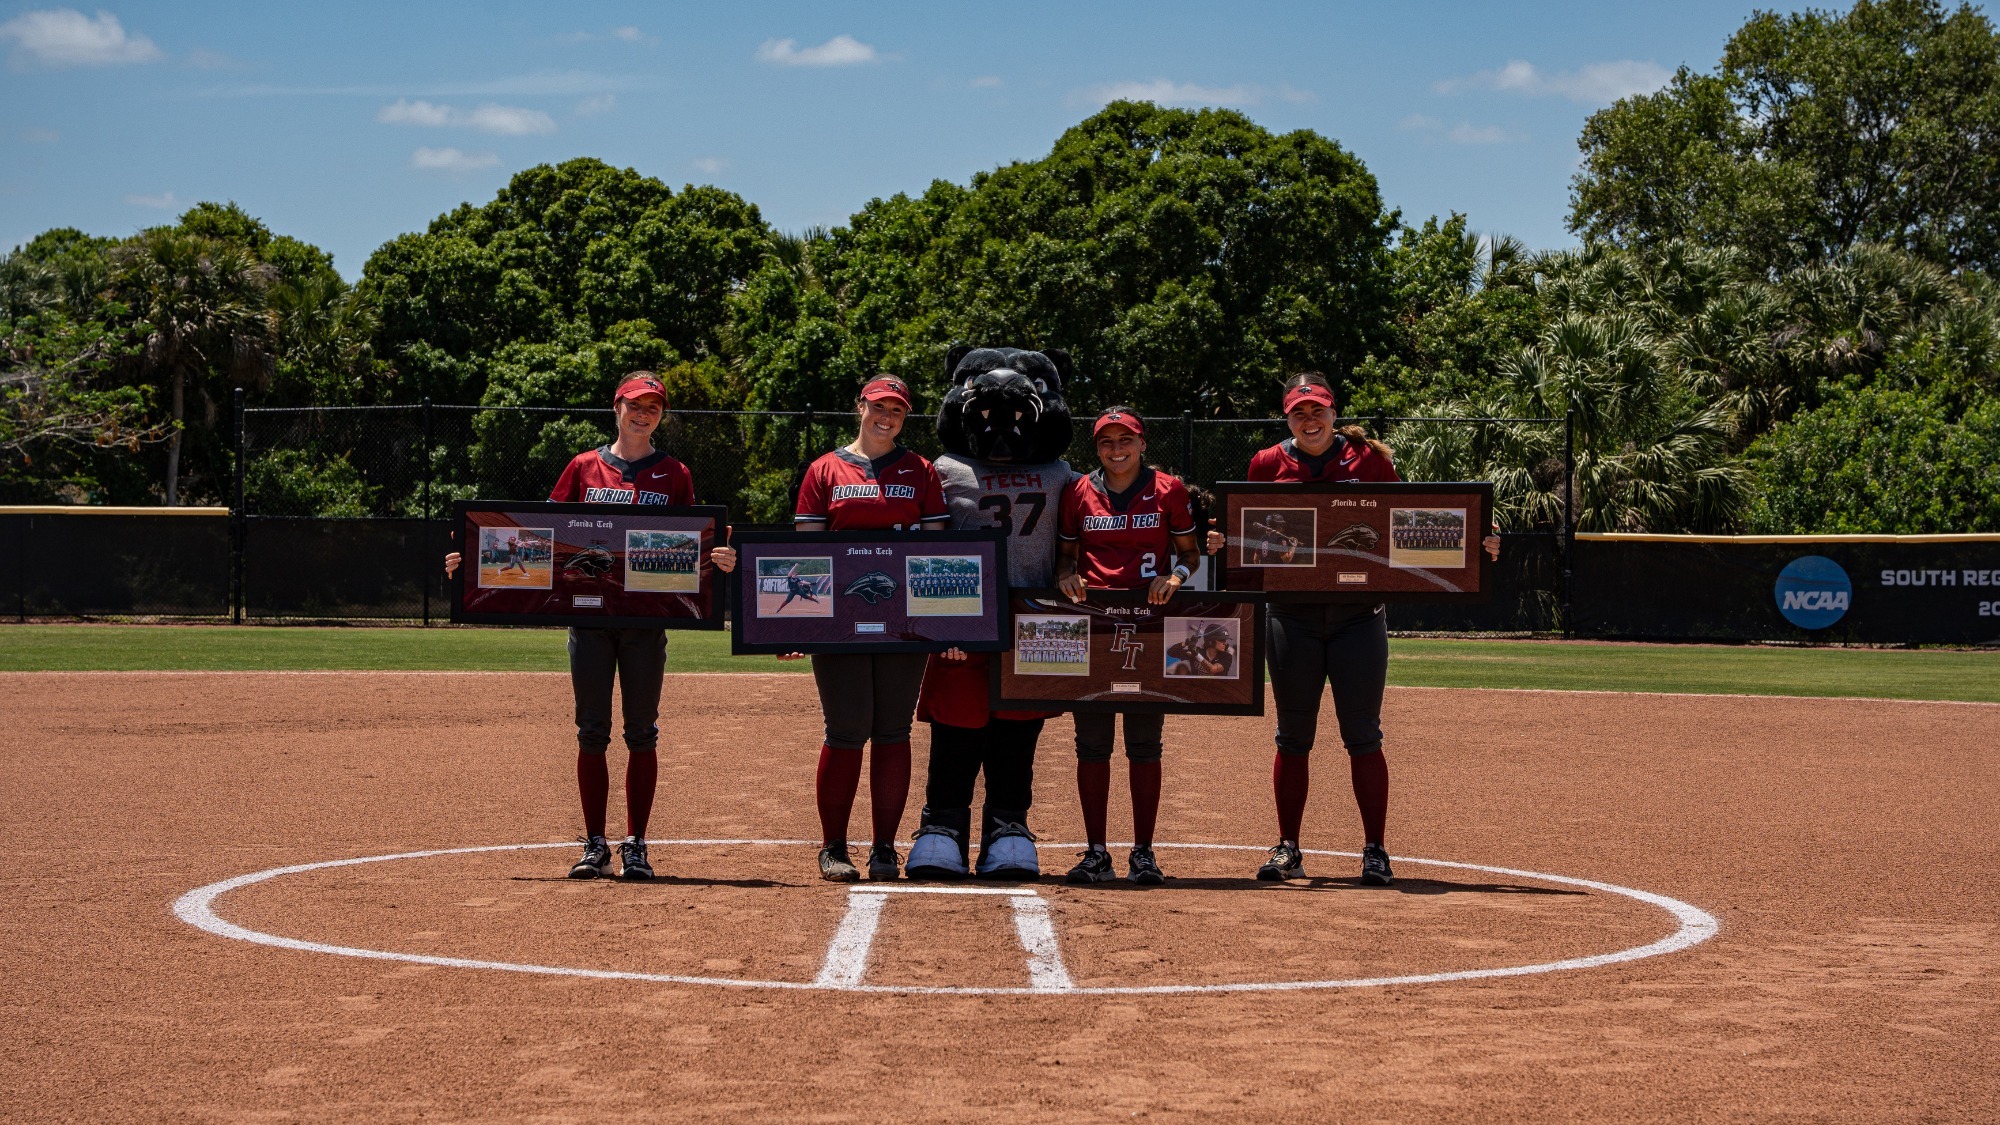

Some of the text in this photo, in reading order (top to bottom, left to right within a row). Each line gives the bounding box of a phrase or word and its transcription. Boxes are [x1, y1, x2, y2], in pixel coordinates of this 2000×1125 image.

[981, 473, 1042, 490] TECH
[584, 487, 669, 505] FLORIDA TECH
[832, 484, 915, 502] FLORIDA TECH
[1331, 499, 1377, 508] Florida Tech
[978, 493, 1047, 537] 37
[1083, 512, 1161, 530] FLORIDA TECH
[567, 519, 613, 530] Florida Tech
[846, 547, 893, 556] Florida Tech
[1140, 552, 1158, 578] 2
[1880, 569, 1957, 587] SOUTH
[1782, 590, 1849, 611] NCAA
[1104, 606, 1151, 616] Florida Tech
